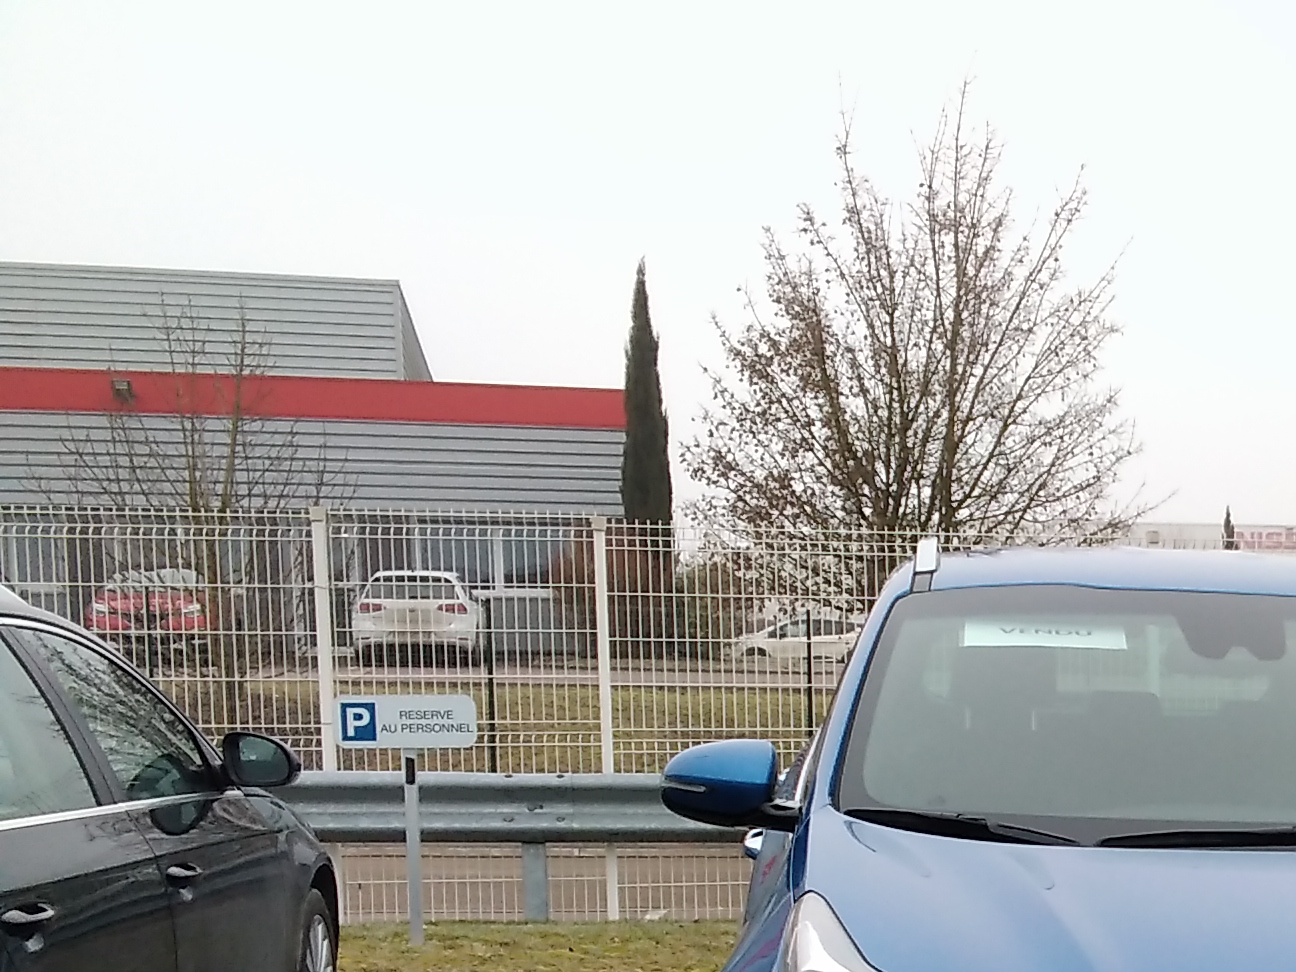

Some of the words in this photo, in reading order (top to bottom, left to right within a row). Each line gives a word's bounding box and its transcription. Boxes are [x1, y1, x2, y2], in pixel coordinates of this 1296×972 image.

[399, 710, 454, 720] RESERVE
[345, 707, 371, 737] P
[380, 724, 398, 734] AU
[400, 723, 473, 734] PERSONNEL
